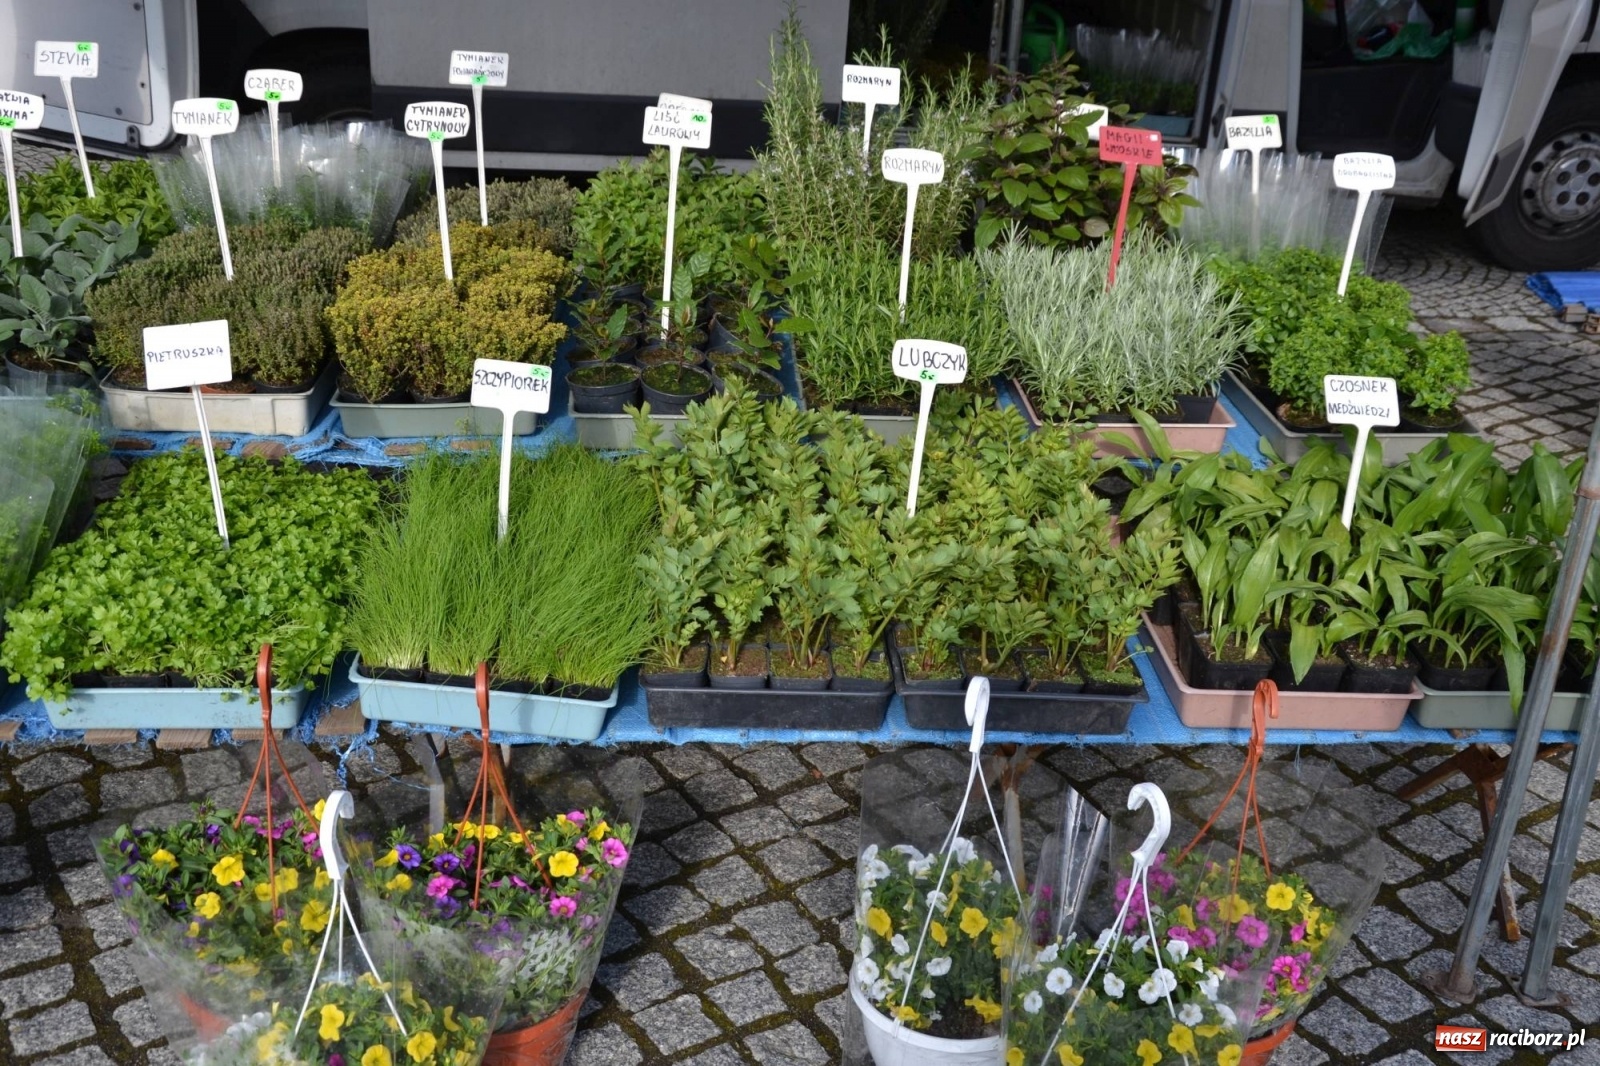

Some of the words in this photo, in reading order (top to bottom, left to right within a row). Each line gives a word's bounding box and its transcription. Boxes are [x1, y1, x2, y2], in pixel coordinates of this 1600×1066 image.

[39, 50, 91, 66] STEVIA
[247, 77, 295, 91] CZABER
[846, 74, 892, 87] ROZMARYN
[172, 111, 233, 127] TYMIANEK
[411, 105, 467, 119] TYMIANEK
[406, 119, 467, 136] CYTRYNOWY
[647, 124, 701, 141] LAUROWY
[1228, 125, 1273, 138] BAZYLIA
[884, 155, 942, 174] ROZMARYN
[146, 345, 224, 363] PIETRUSZKA
[899, 346, 966, 372] LUBCZYK
[474, 369, 549, 394] SZCZYPIOREK
[1330, 379, 1389, 393] CZOSNEK
